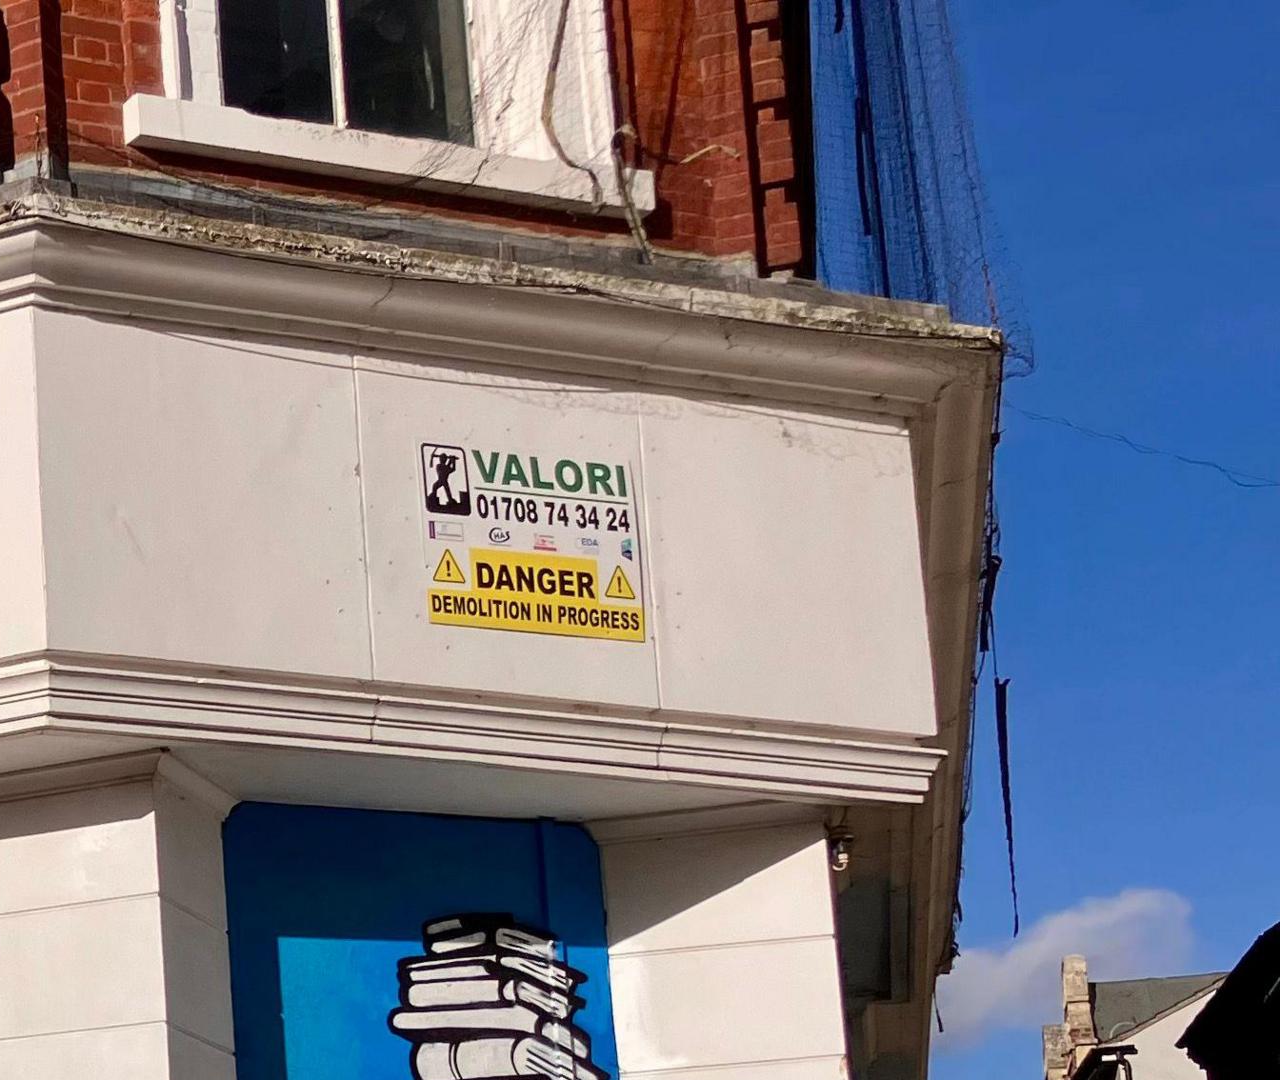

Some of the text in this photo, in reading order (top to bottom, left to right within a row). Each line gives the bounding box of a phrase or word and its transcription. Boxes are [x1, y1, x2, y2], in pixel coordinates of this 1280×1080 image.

[471, 449, 628, 497] VALORI
[477, 494, 631, 533] 01708 74 34 24
[476, 562, 596, 599] DANGER
[431, 594, 640, 631] DEMOLITION IN PROGRESS
